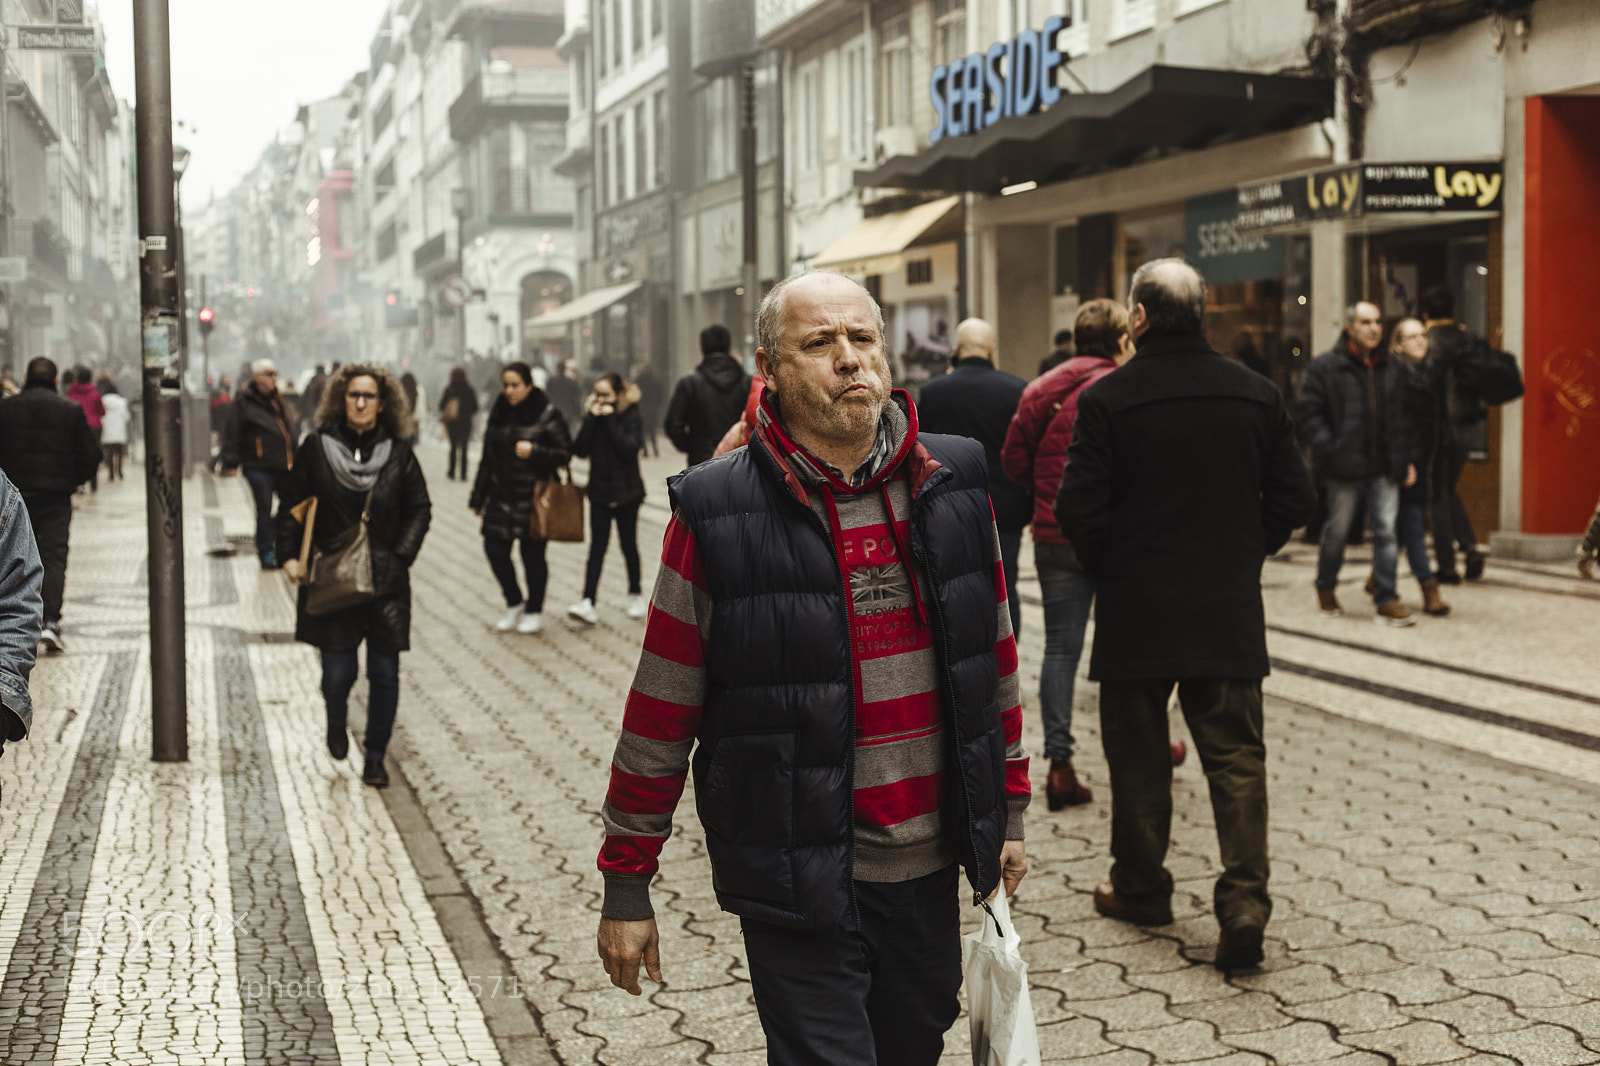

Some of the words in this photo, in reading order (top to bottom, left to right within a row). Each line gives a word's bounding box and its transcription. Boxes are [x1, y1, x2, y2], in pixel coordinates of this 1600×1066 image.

[929, 15, 1066, 144] SEASIDE
[862, 535, 911, 559] PO
[865, 604, 907, 620] ROYAL
[883, 620, 901, 634] OF
